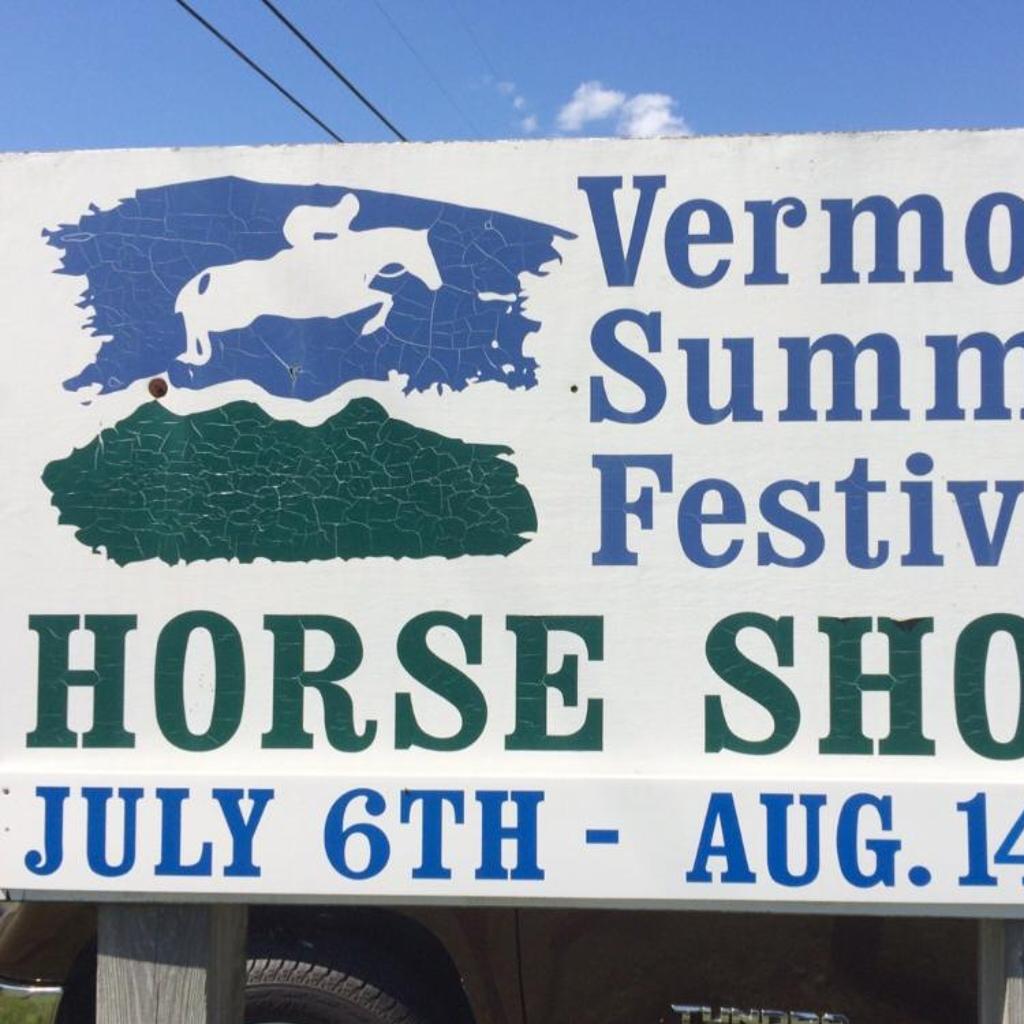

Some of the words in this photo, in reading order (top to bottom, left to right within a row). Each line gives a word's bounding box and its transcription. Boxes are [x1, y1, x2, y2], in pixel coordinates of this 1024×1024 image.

[25, 609, 605, 753] HORSE
[24, 786, 275, 878] JULY
[323, 788, 546, 881] 6TH
